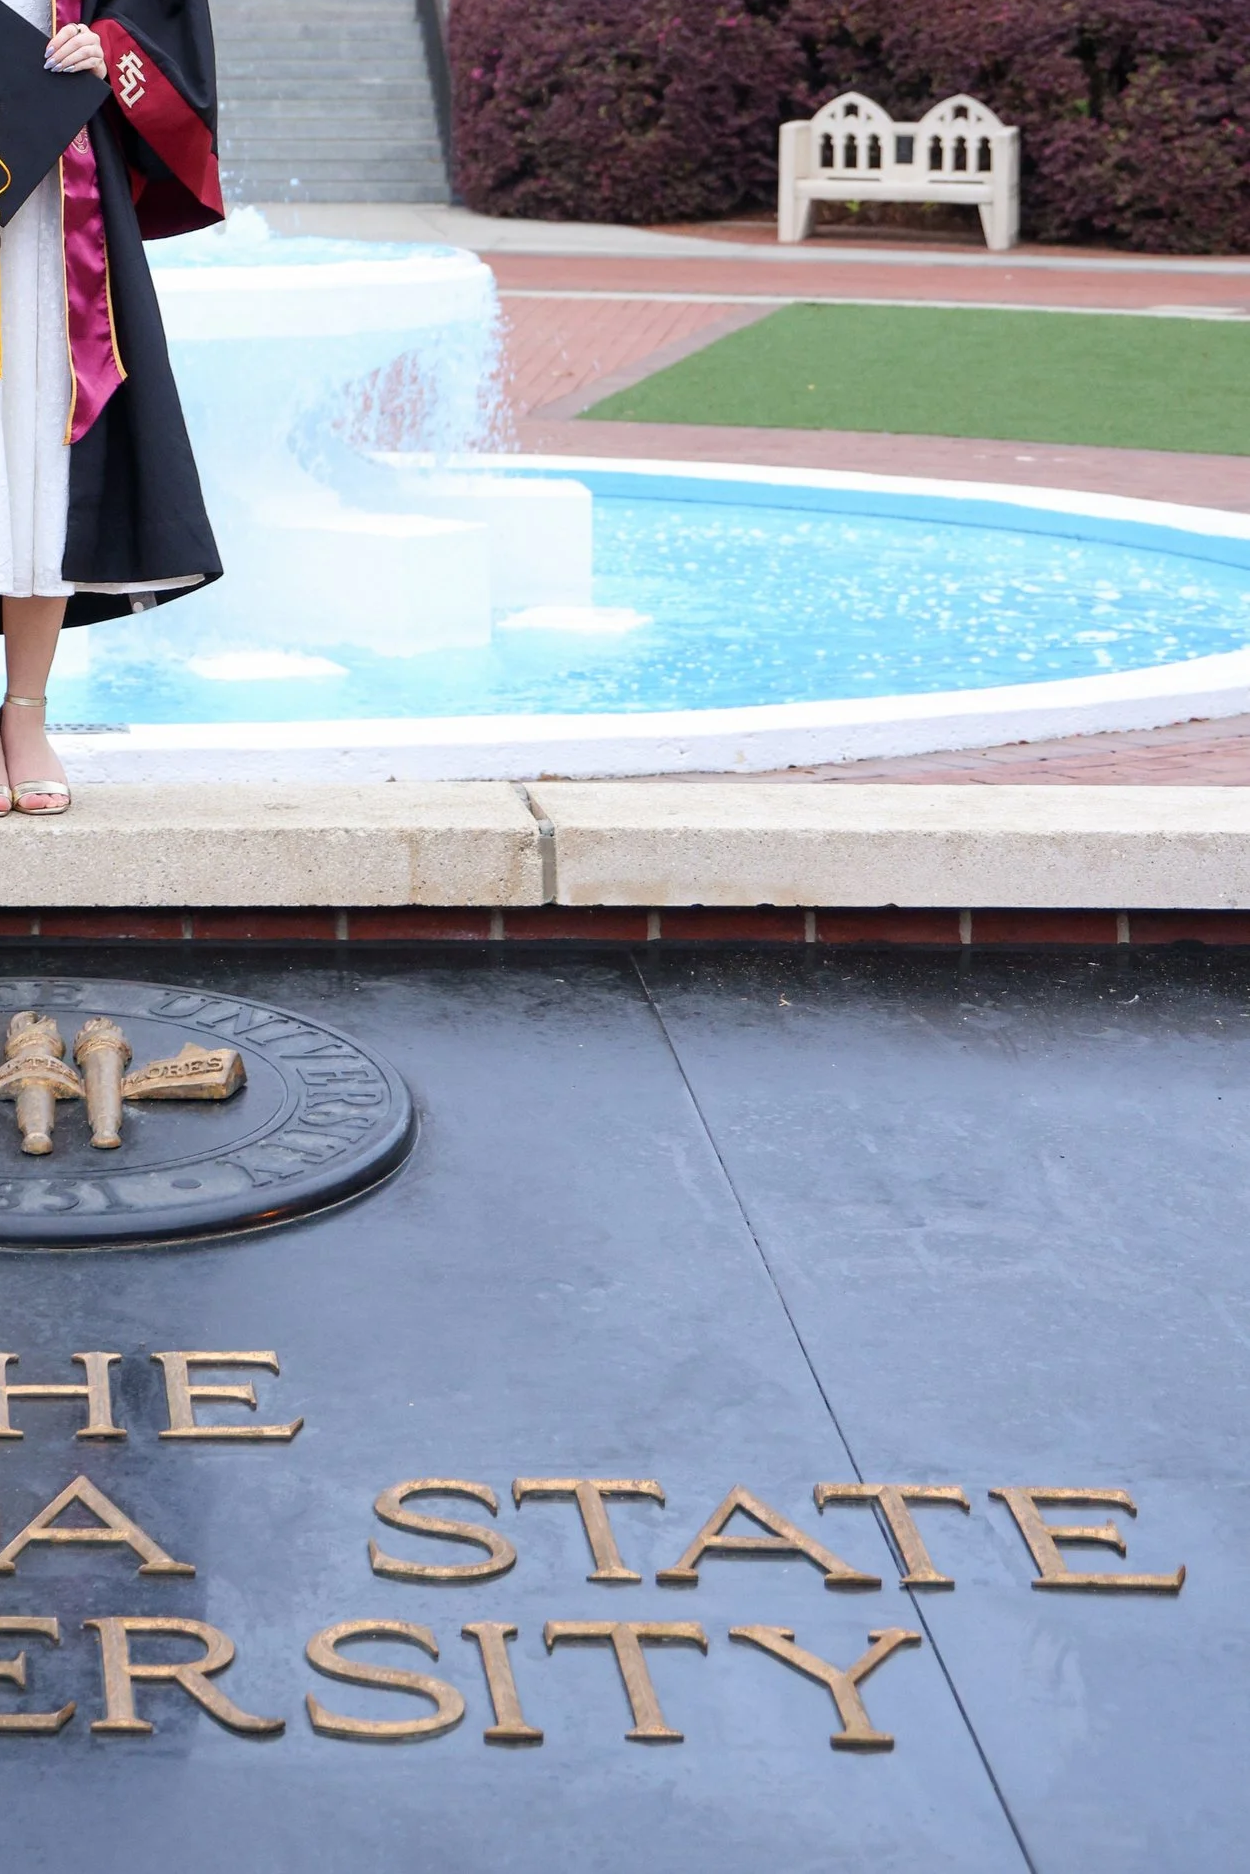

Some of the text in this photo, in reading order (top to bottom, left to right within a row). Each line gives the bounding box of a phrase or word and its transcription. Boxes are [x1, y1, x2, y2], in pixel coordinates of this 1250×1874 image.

[116, 50, 146, 108] FSU
[149, 991, 383, 1187] UNIVERSITY
[368, 1477, 1186, 1594] STATE
